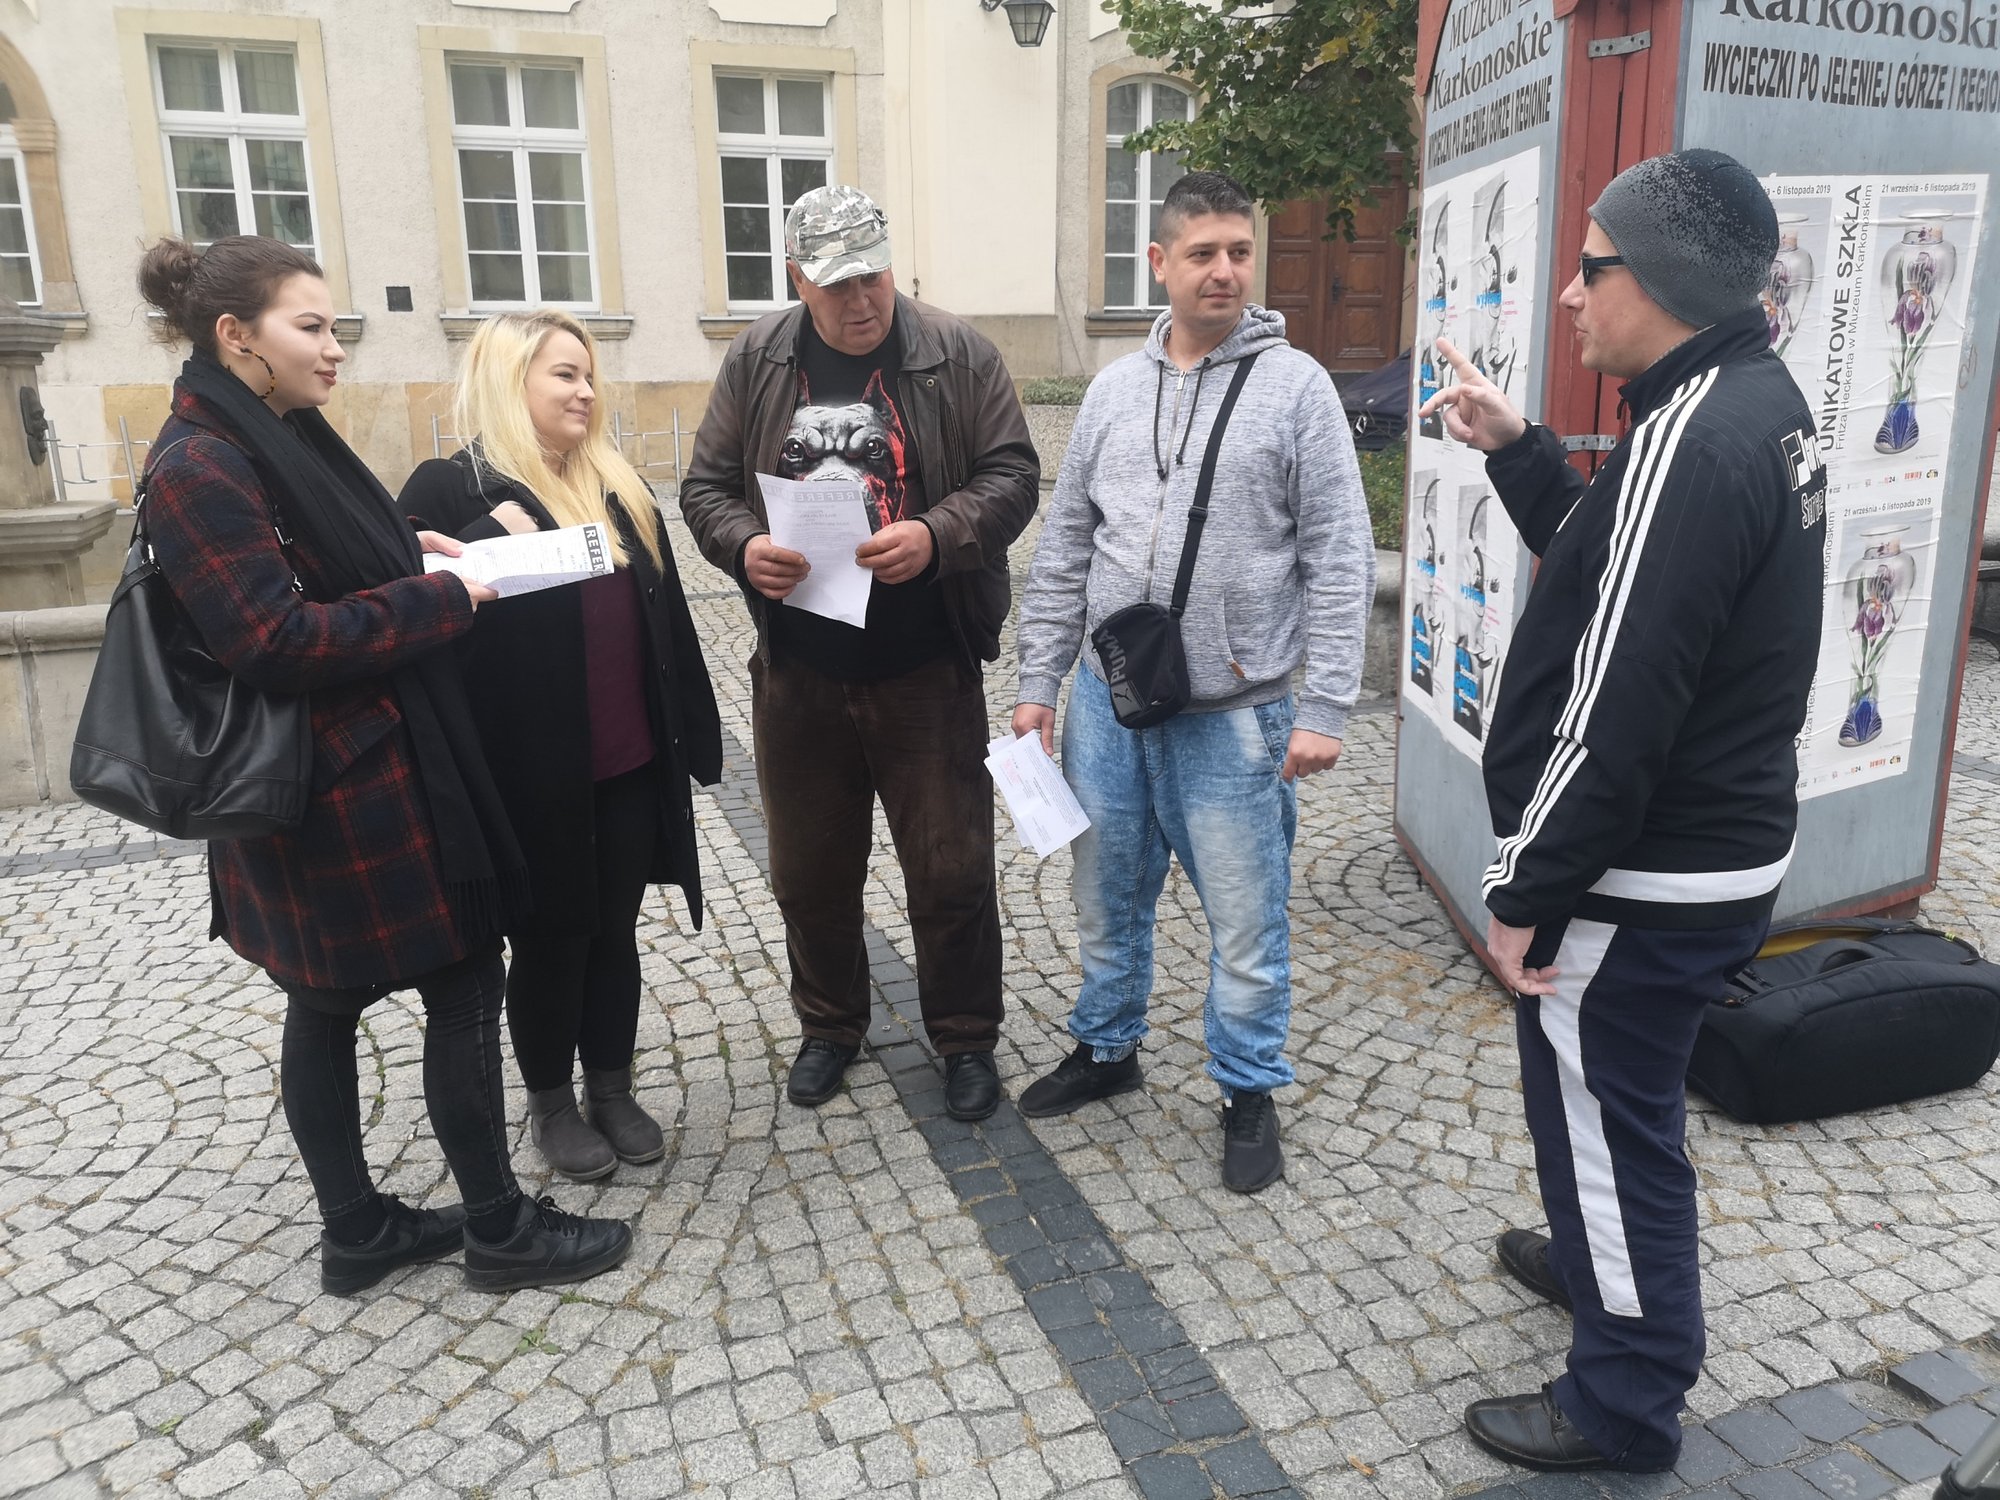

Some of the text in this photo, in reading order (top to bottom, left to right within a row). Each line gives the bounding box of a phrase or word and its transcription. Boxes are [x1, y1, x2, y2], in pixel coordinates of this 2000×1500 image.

[1432, 11, 1553, 114] Karkonoskie
[1702, 41, 2000, 114] WYCIECZKI PO JELENIEJ GÓRZE I REGIO
[1514, 74, 1553, 134] REGIONIE
[1782, 184, 1815, 196] listopada
[1815, 184, 1831, 194] 2019
[1881, 184, 1889, 193] 21
[1890, 183, 1919, 194] września
[1930, 182, 1960, 194] listopada
[1960, 181, 1976, 192] 2019
[1855, 184, 1873, 272] Karkonoskim
[1821, 287, 1850, 451] UNIKATOWE
[1837, 184, 1862, 279] SZKŁA
[1848, 276, 1863, 334] Muzeum
[1842, 352, 1855, 410] Heckerta
[1835, 414, 1849, 450] Fritza
[1844, 508, 1851, 517] 21
[1887, 501, 1915, 511] listopada
[1916, 497, 1932, 508] 2019
[1097, 628, 1126, 682] PUMA
